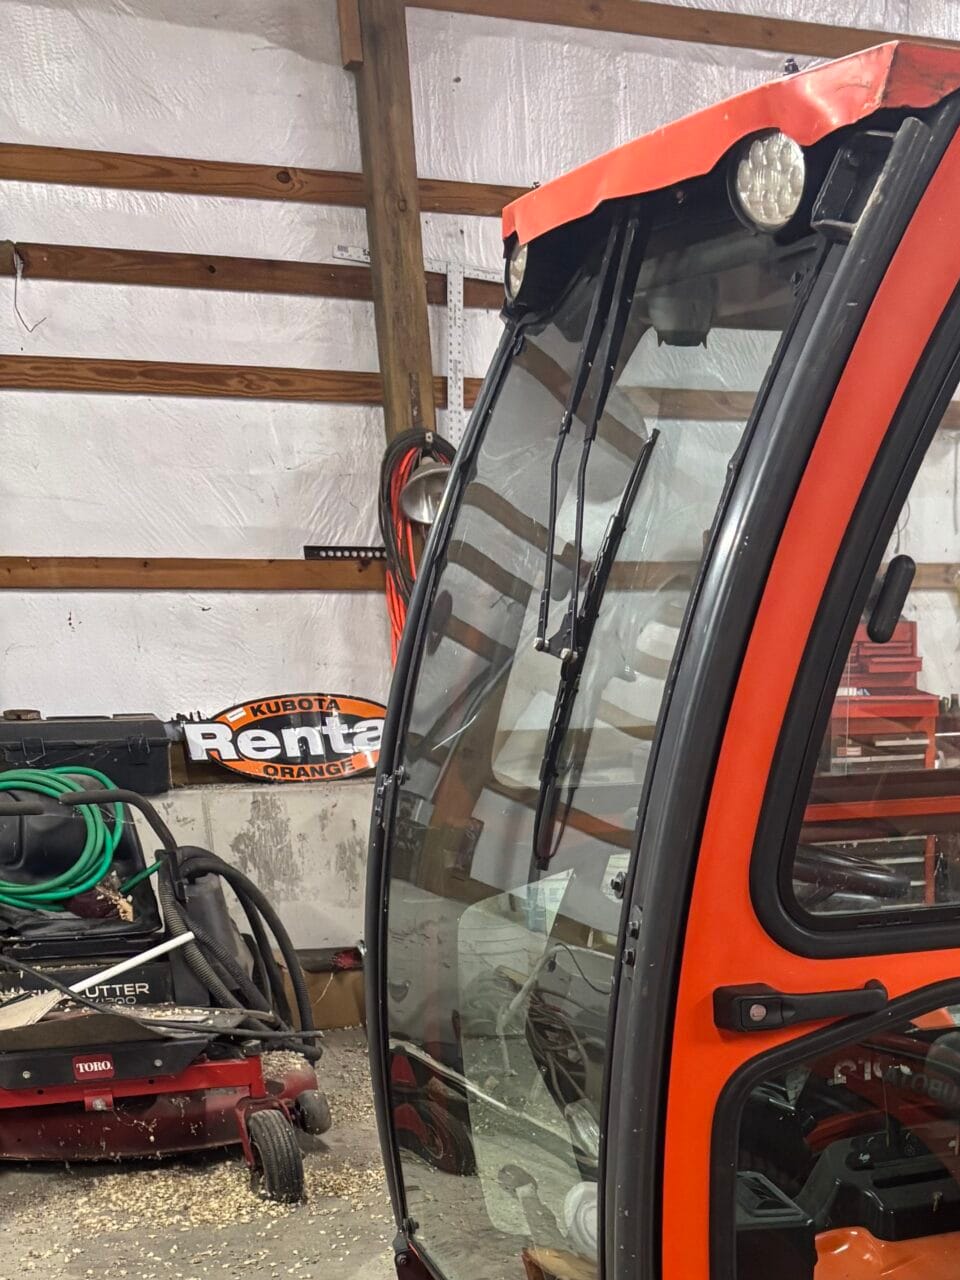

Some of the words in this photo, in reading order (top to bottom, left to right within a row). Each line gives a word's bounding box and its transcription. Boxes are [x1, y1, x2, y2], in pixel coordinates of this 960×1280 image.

[249, 698, 341, 718] KUBOTA
[183, 714, 386, 761] Renta
[262, 759, 356, 779] ORANGE
